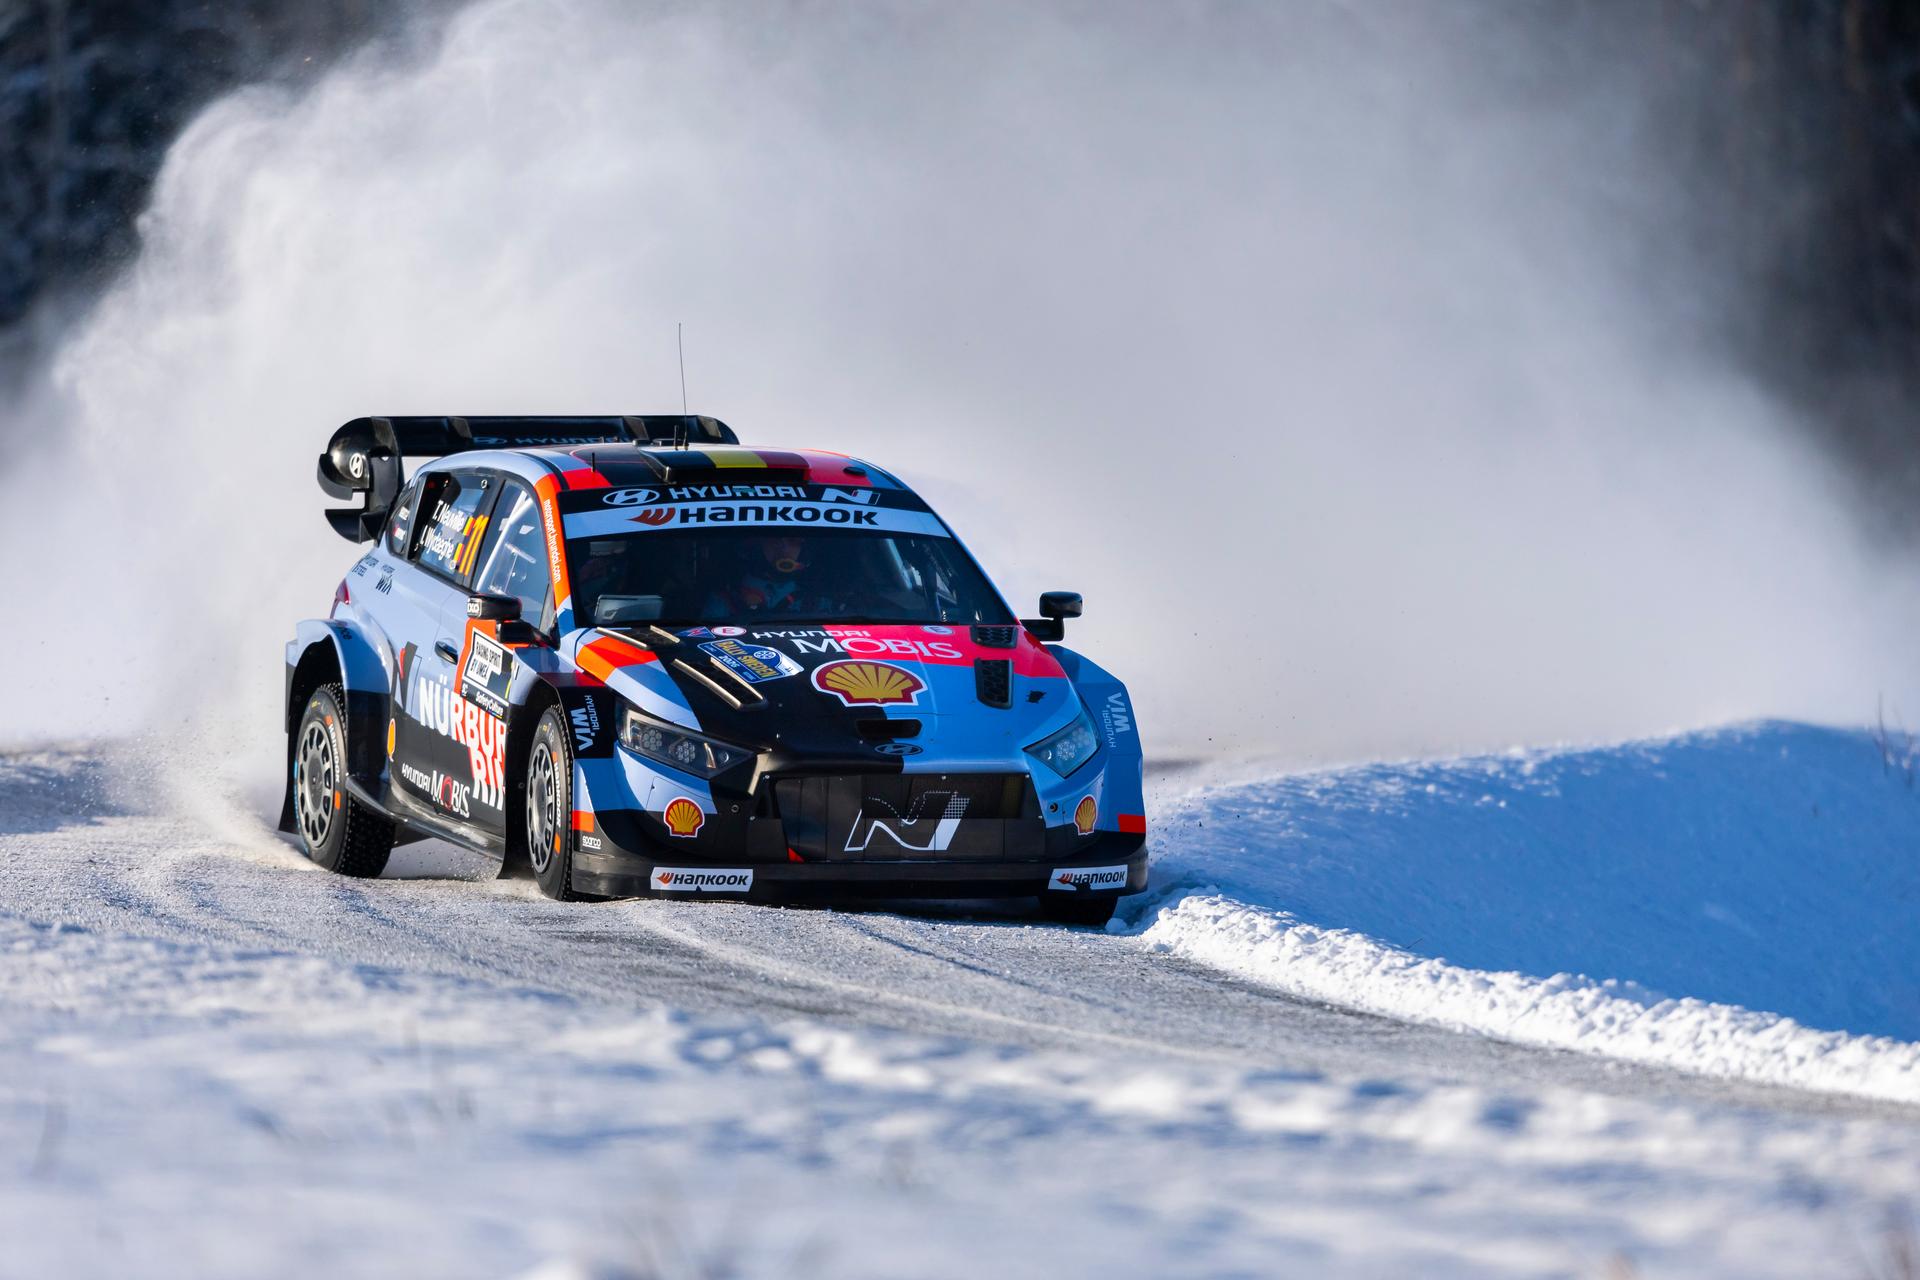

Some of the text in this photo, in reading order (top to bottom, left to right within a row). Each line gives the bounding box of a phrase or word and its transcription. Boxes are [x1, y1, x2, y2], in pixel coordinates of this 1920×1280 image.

[669, 485, 807, 500] HYUNDAI
[437, 503, 467, 533] Neuville
[458, 513, 489, 577] 11
[544, 498, 561, 584] motorsport.hyundai.com
[752, 629, 872, 640] HYUNDAI
[791, 637, 964, 659] MOBIS
[714, 641, 748, 656] RALLY
[737, 655, 780, 678] SWEDEN
[570, 707, 594, 751] WIA
[584, 694, 600, 731] HYUNDAI
[1102, 710, 1117, 748] HYUNDAI
[1107, 692, 1131, 734] WIA
[402, 762, 470, 819] HYUNDAI MOBIS
[582, 835, 602, 847] sparco
